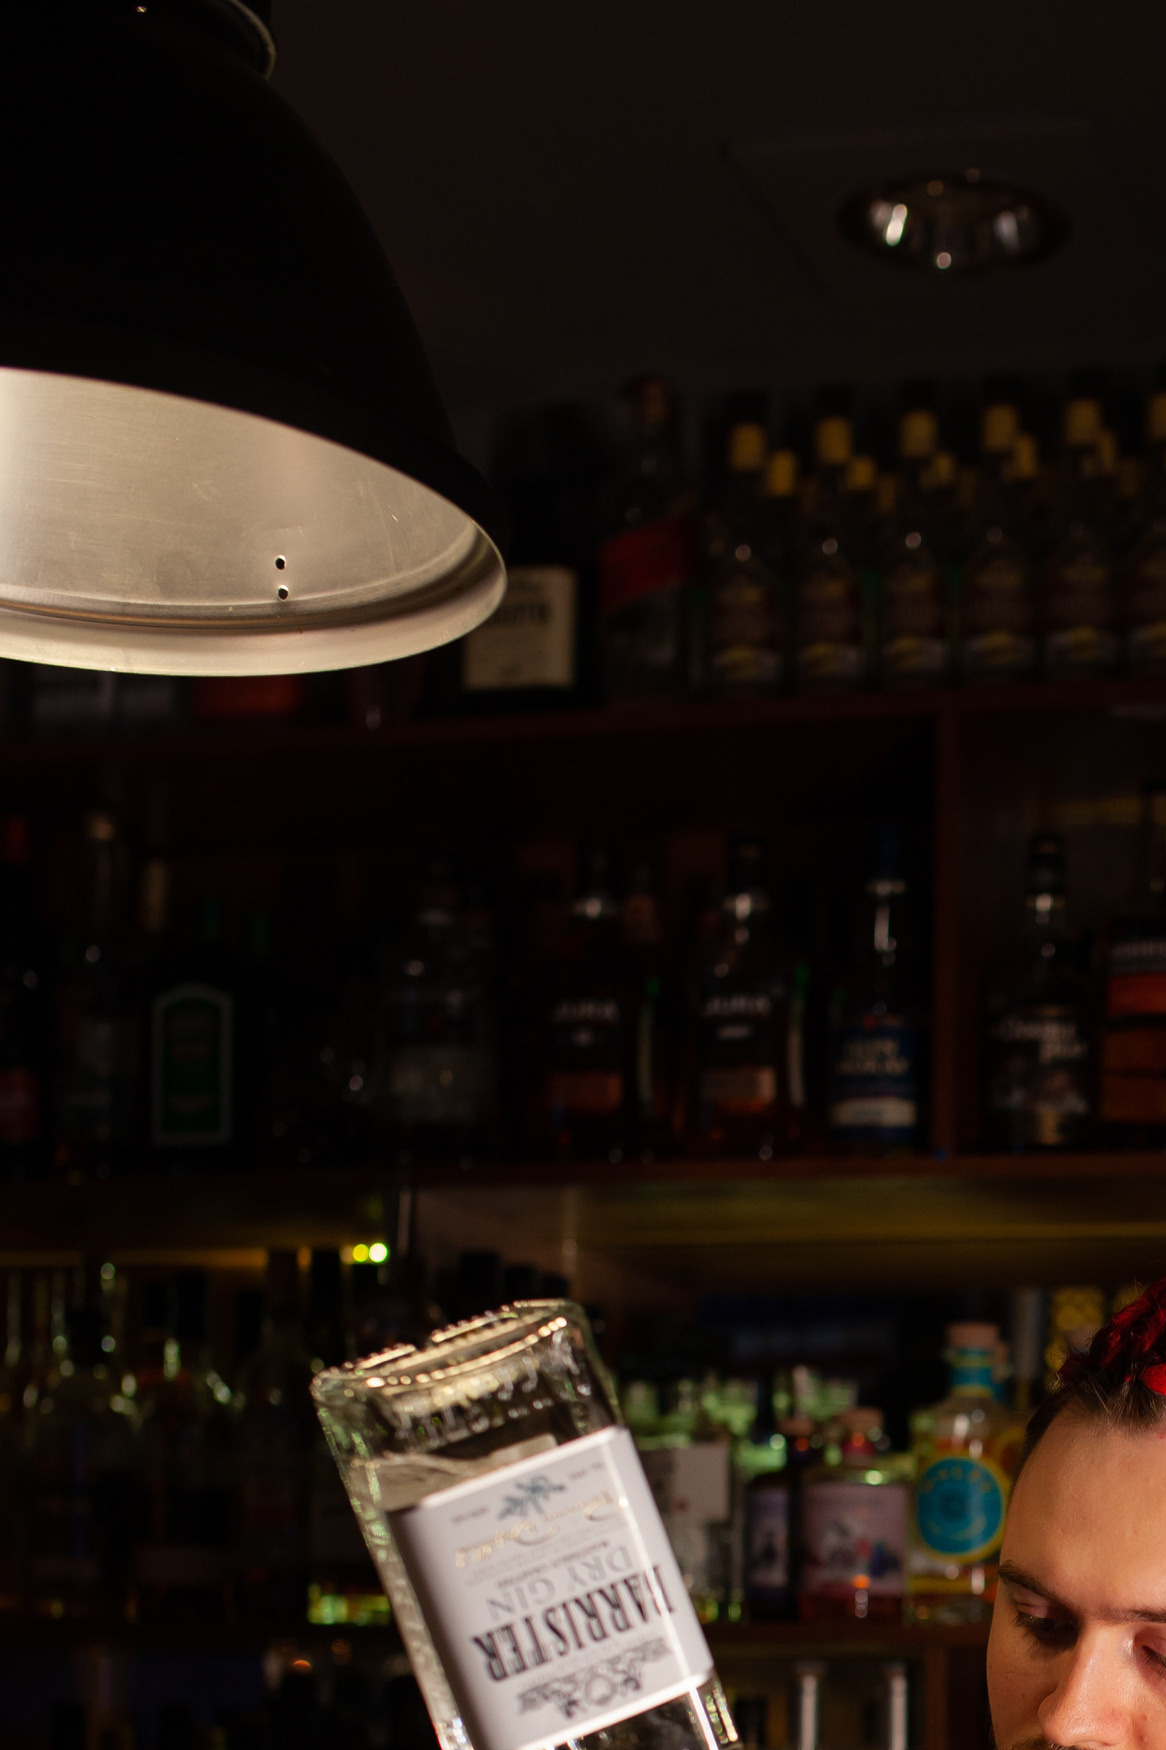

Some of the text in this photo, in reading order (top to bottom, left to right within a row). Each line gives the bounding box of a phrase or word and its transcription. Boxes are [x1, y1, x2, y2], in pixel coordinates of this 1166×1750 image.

[568, 1544, 633, 1594] DRY
[471, 1563, 677, 1683] BARRISTER
[486, 1577, 556, 1623] GIN
